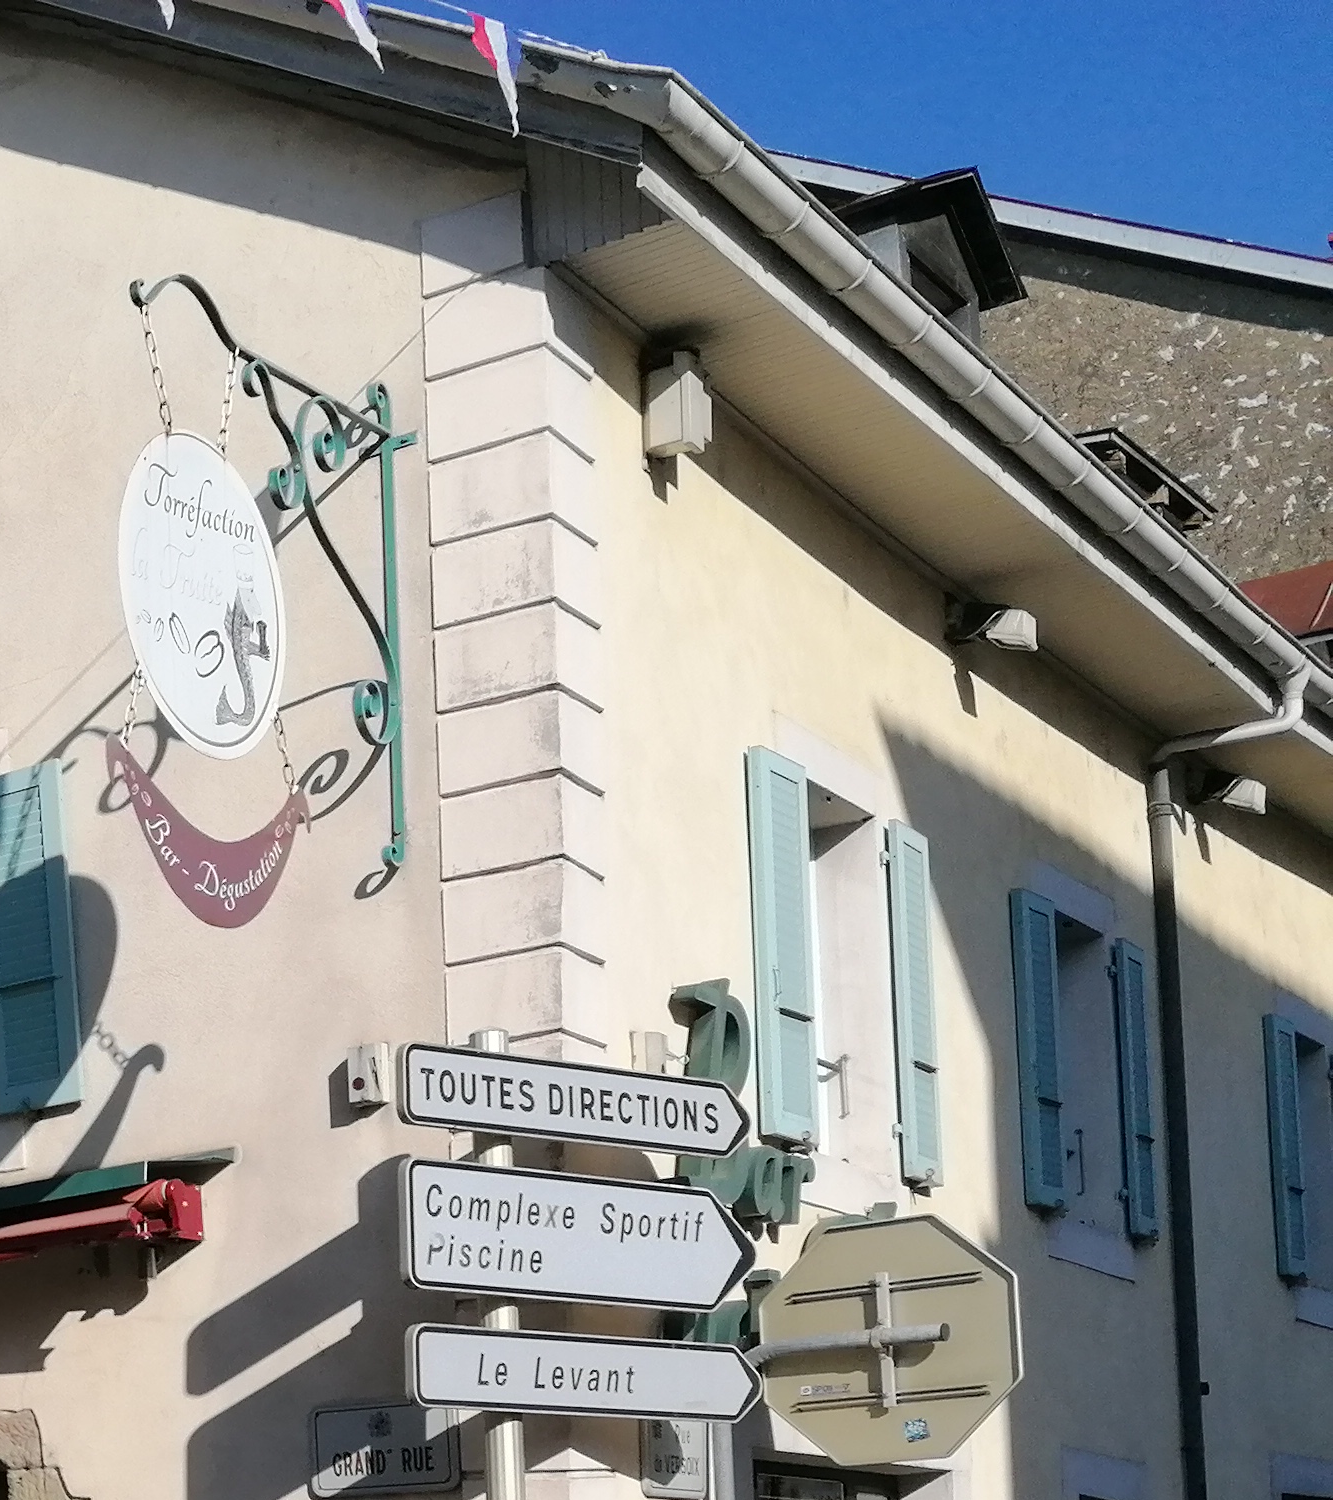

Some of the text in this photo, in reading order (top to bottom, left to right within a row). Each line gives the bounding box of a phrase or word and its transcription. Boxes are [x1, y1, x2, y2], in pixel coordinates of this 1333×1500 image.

[144, 462, 255, 543] Torréfaction
[144, 813, 181, 867] Bar
[193, 840, 284, 911] Dégustation
[420, 1067, 720, 1134] TOUTES DIRECTIONS
[425, 1183, 704, 1243] Complexe Sportif
[426, 1232, 543, 1274] Piscine
[477, 1352, 635, 1394] Le Levant
[400, 1446, 435, 1474] RUE
